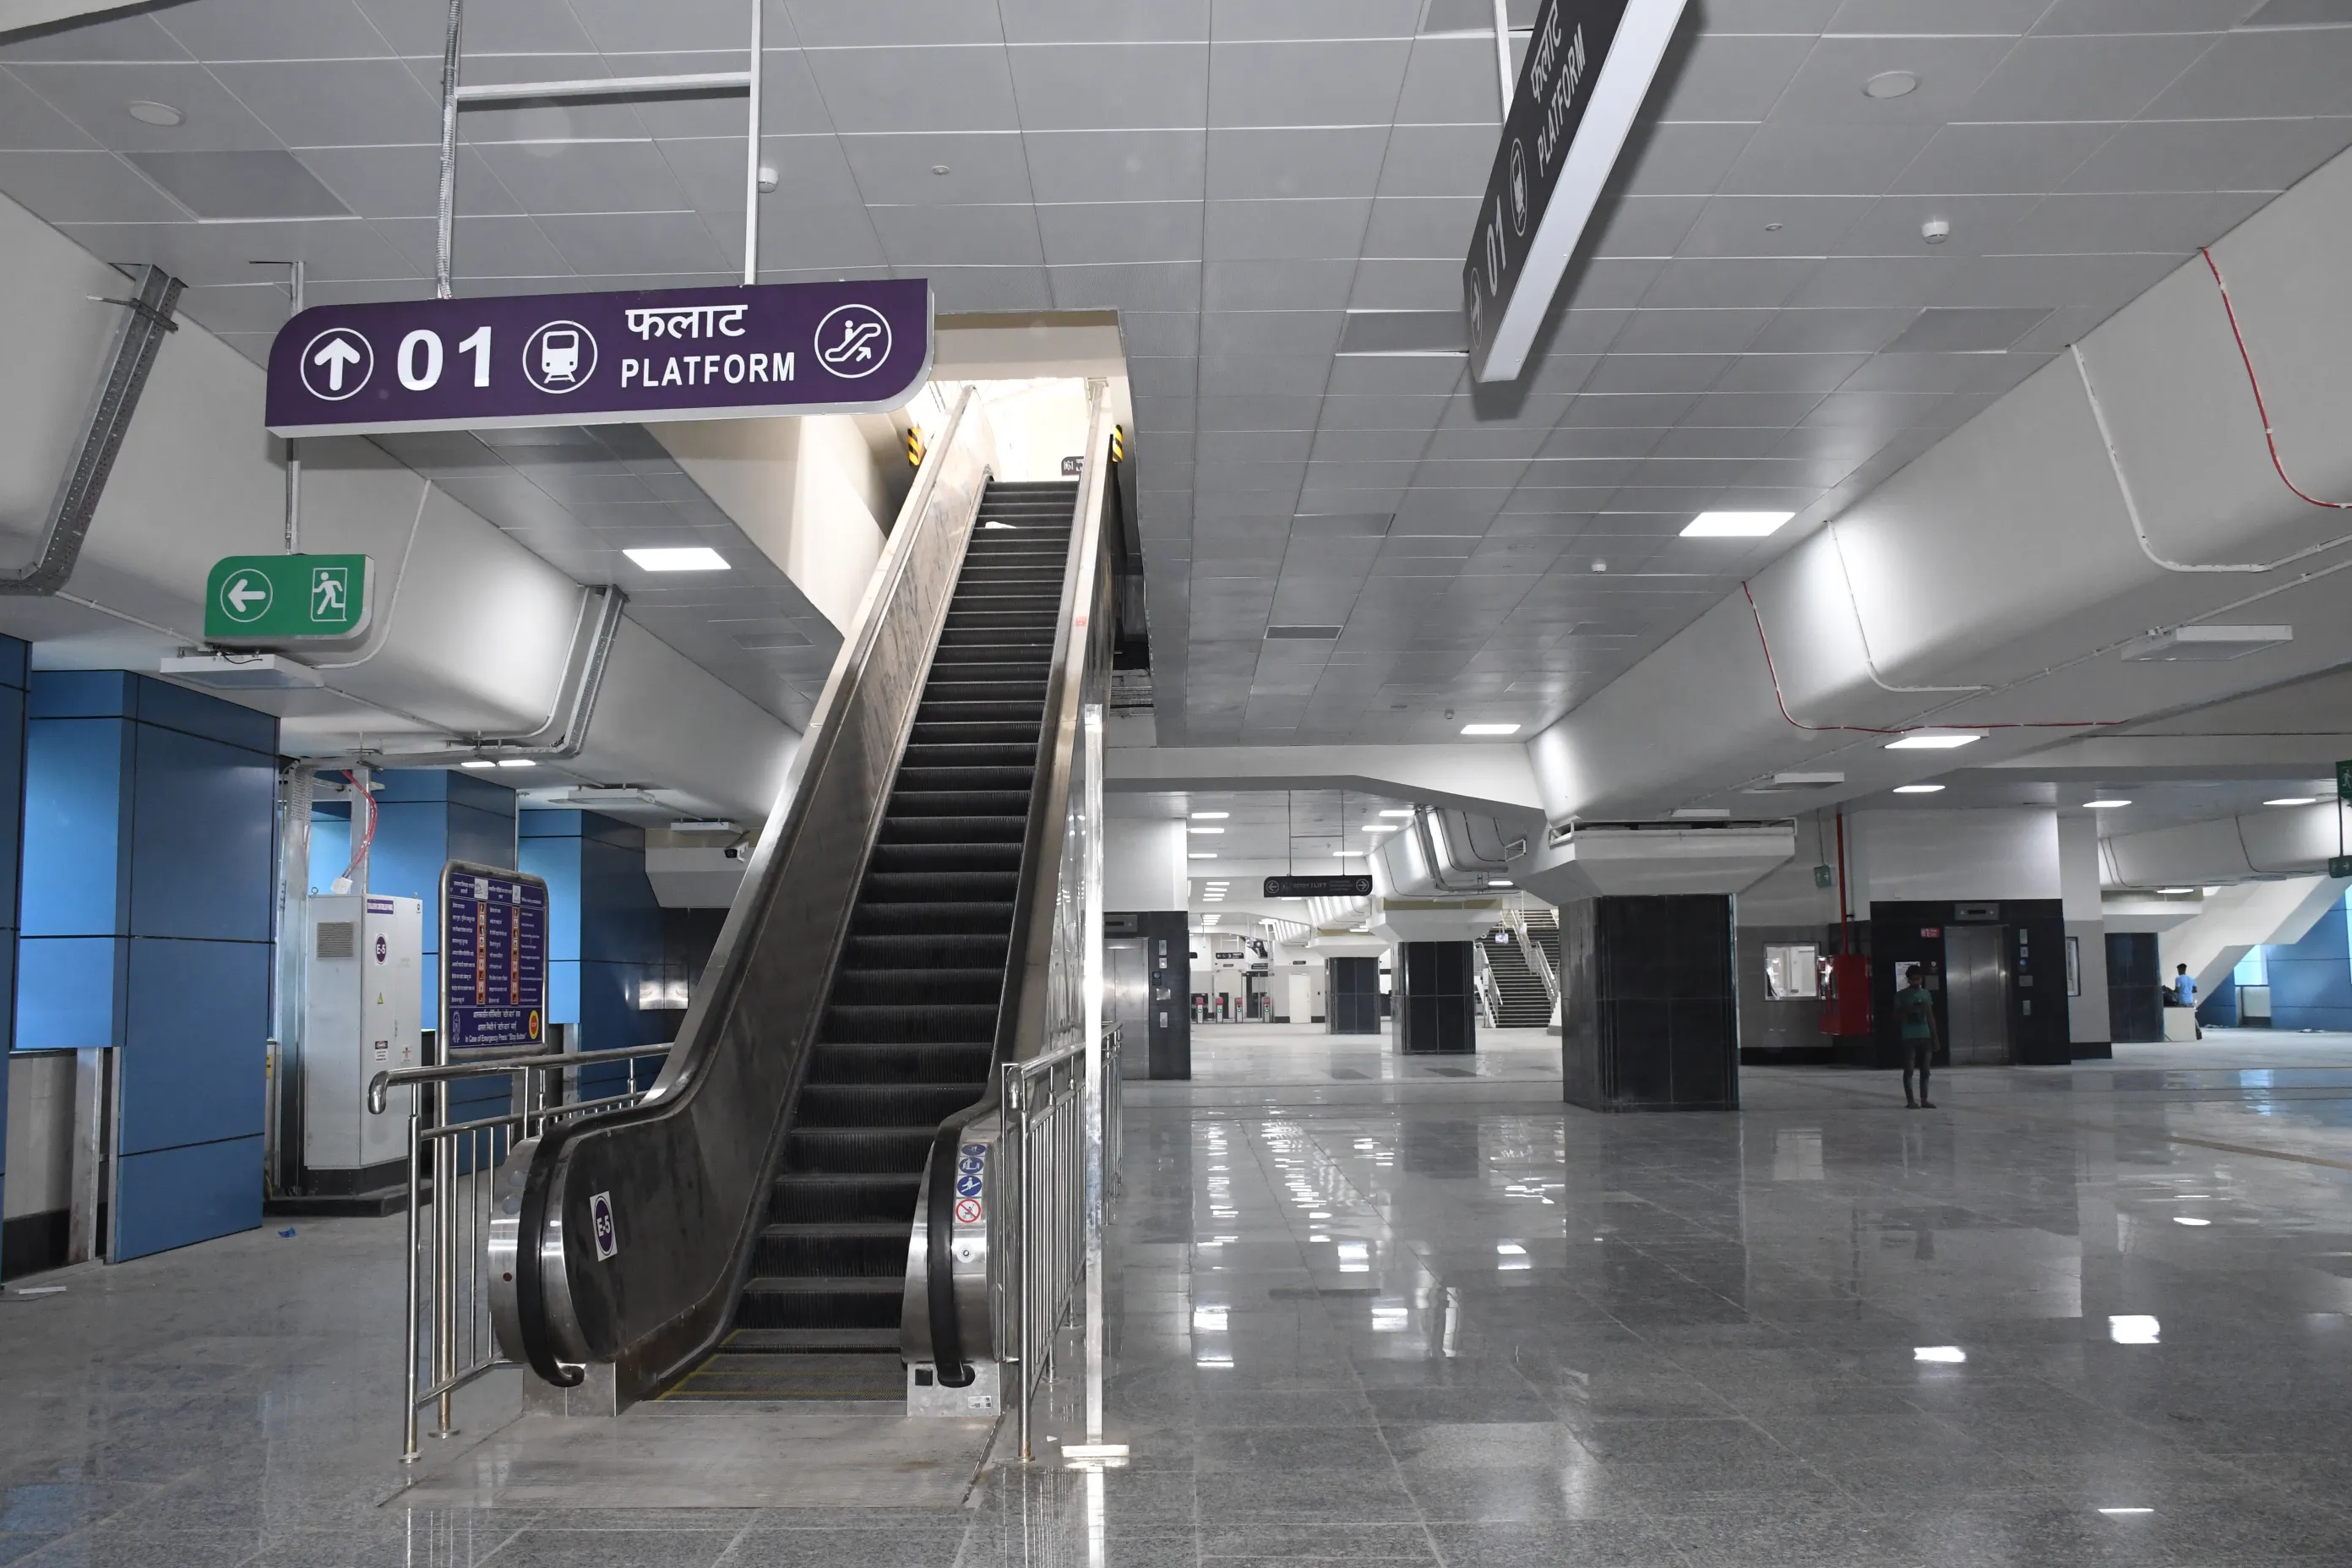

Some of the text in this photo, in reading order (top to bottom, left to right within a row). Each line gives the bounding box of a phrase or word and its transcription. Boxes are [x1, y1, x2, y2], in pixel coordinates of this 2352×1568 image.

[1537, 22, 1586, 178] PLATFORM
[1487, 194, 1506, 297] 01
[624, 303, 748, 341] फलाट
[397, 325, 492, 390] 01
[621, 351, 796, 388] PLATFORM
[596, 1215, 611, 1237] E-5
